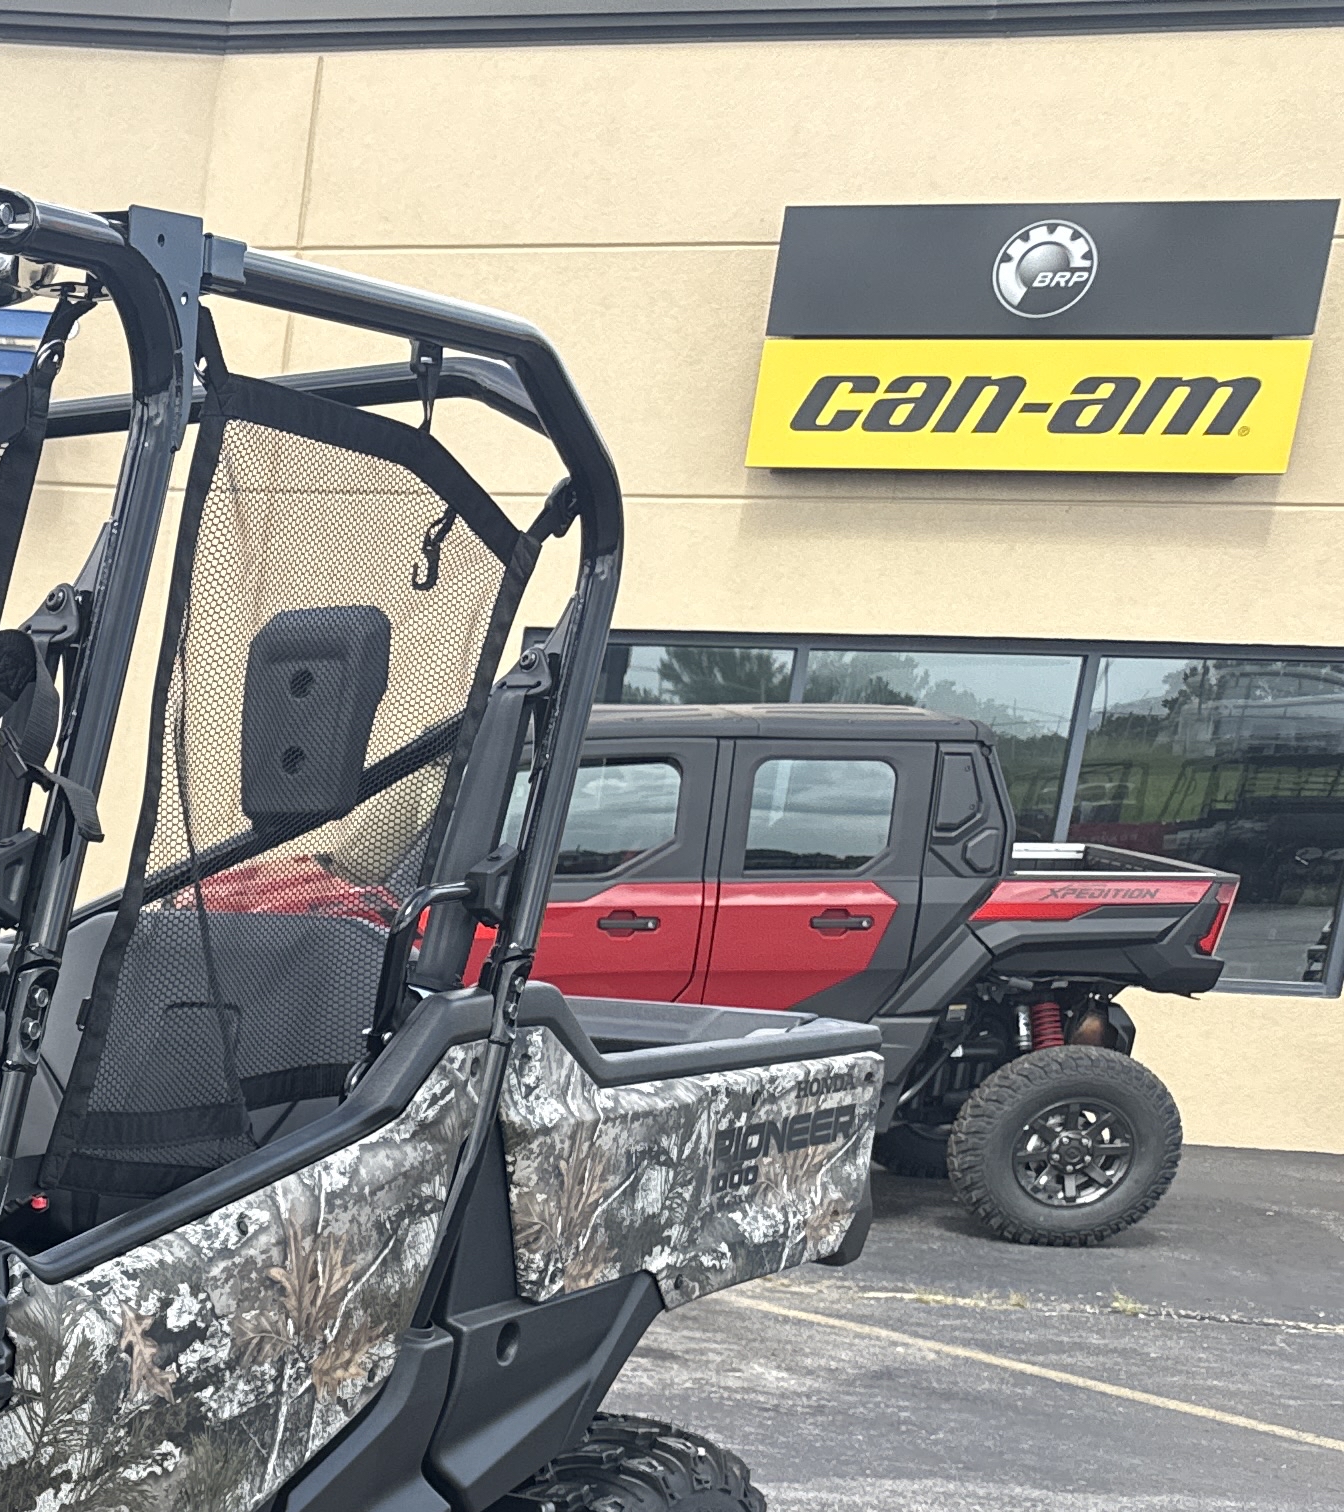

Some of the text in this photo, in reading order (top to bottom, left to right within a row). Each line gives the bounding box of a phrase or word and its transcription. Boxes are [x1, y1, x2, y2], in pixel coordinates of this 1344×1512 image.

[1031, 271, 1090, 288] BRP
[789, 374, 1263, 437] can-am
[1039, 885, 1161, 901] XPEDITION
[795, 1073, 856, 1099] HONDA
[714, 1103, 856, 1167] PIONEER
